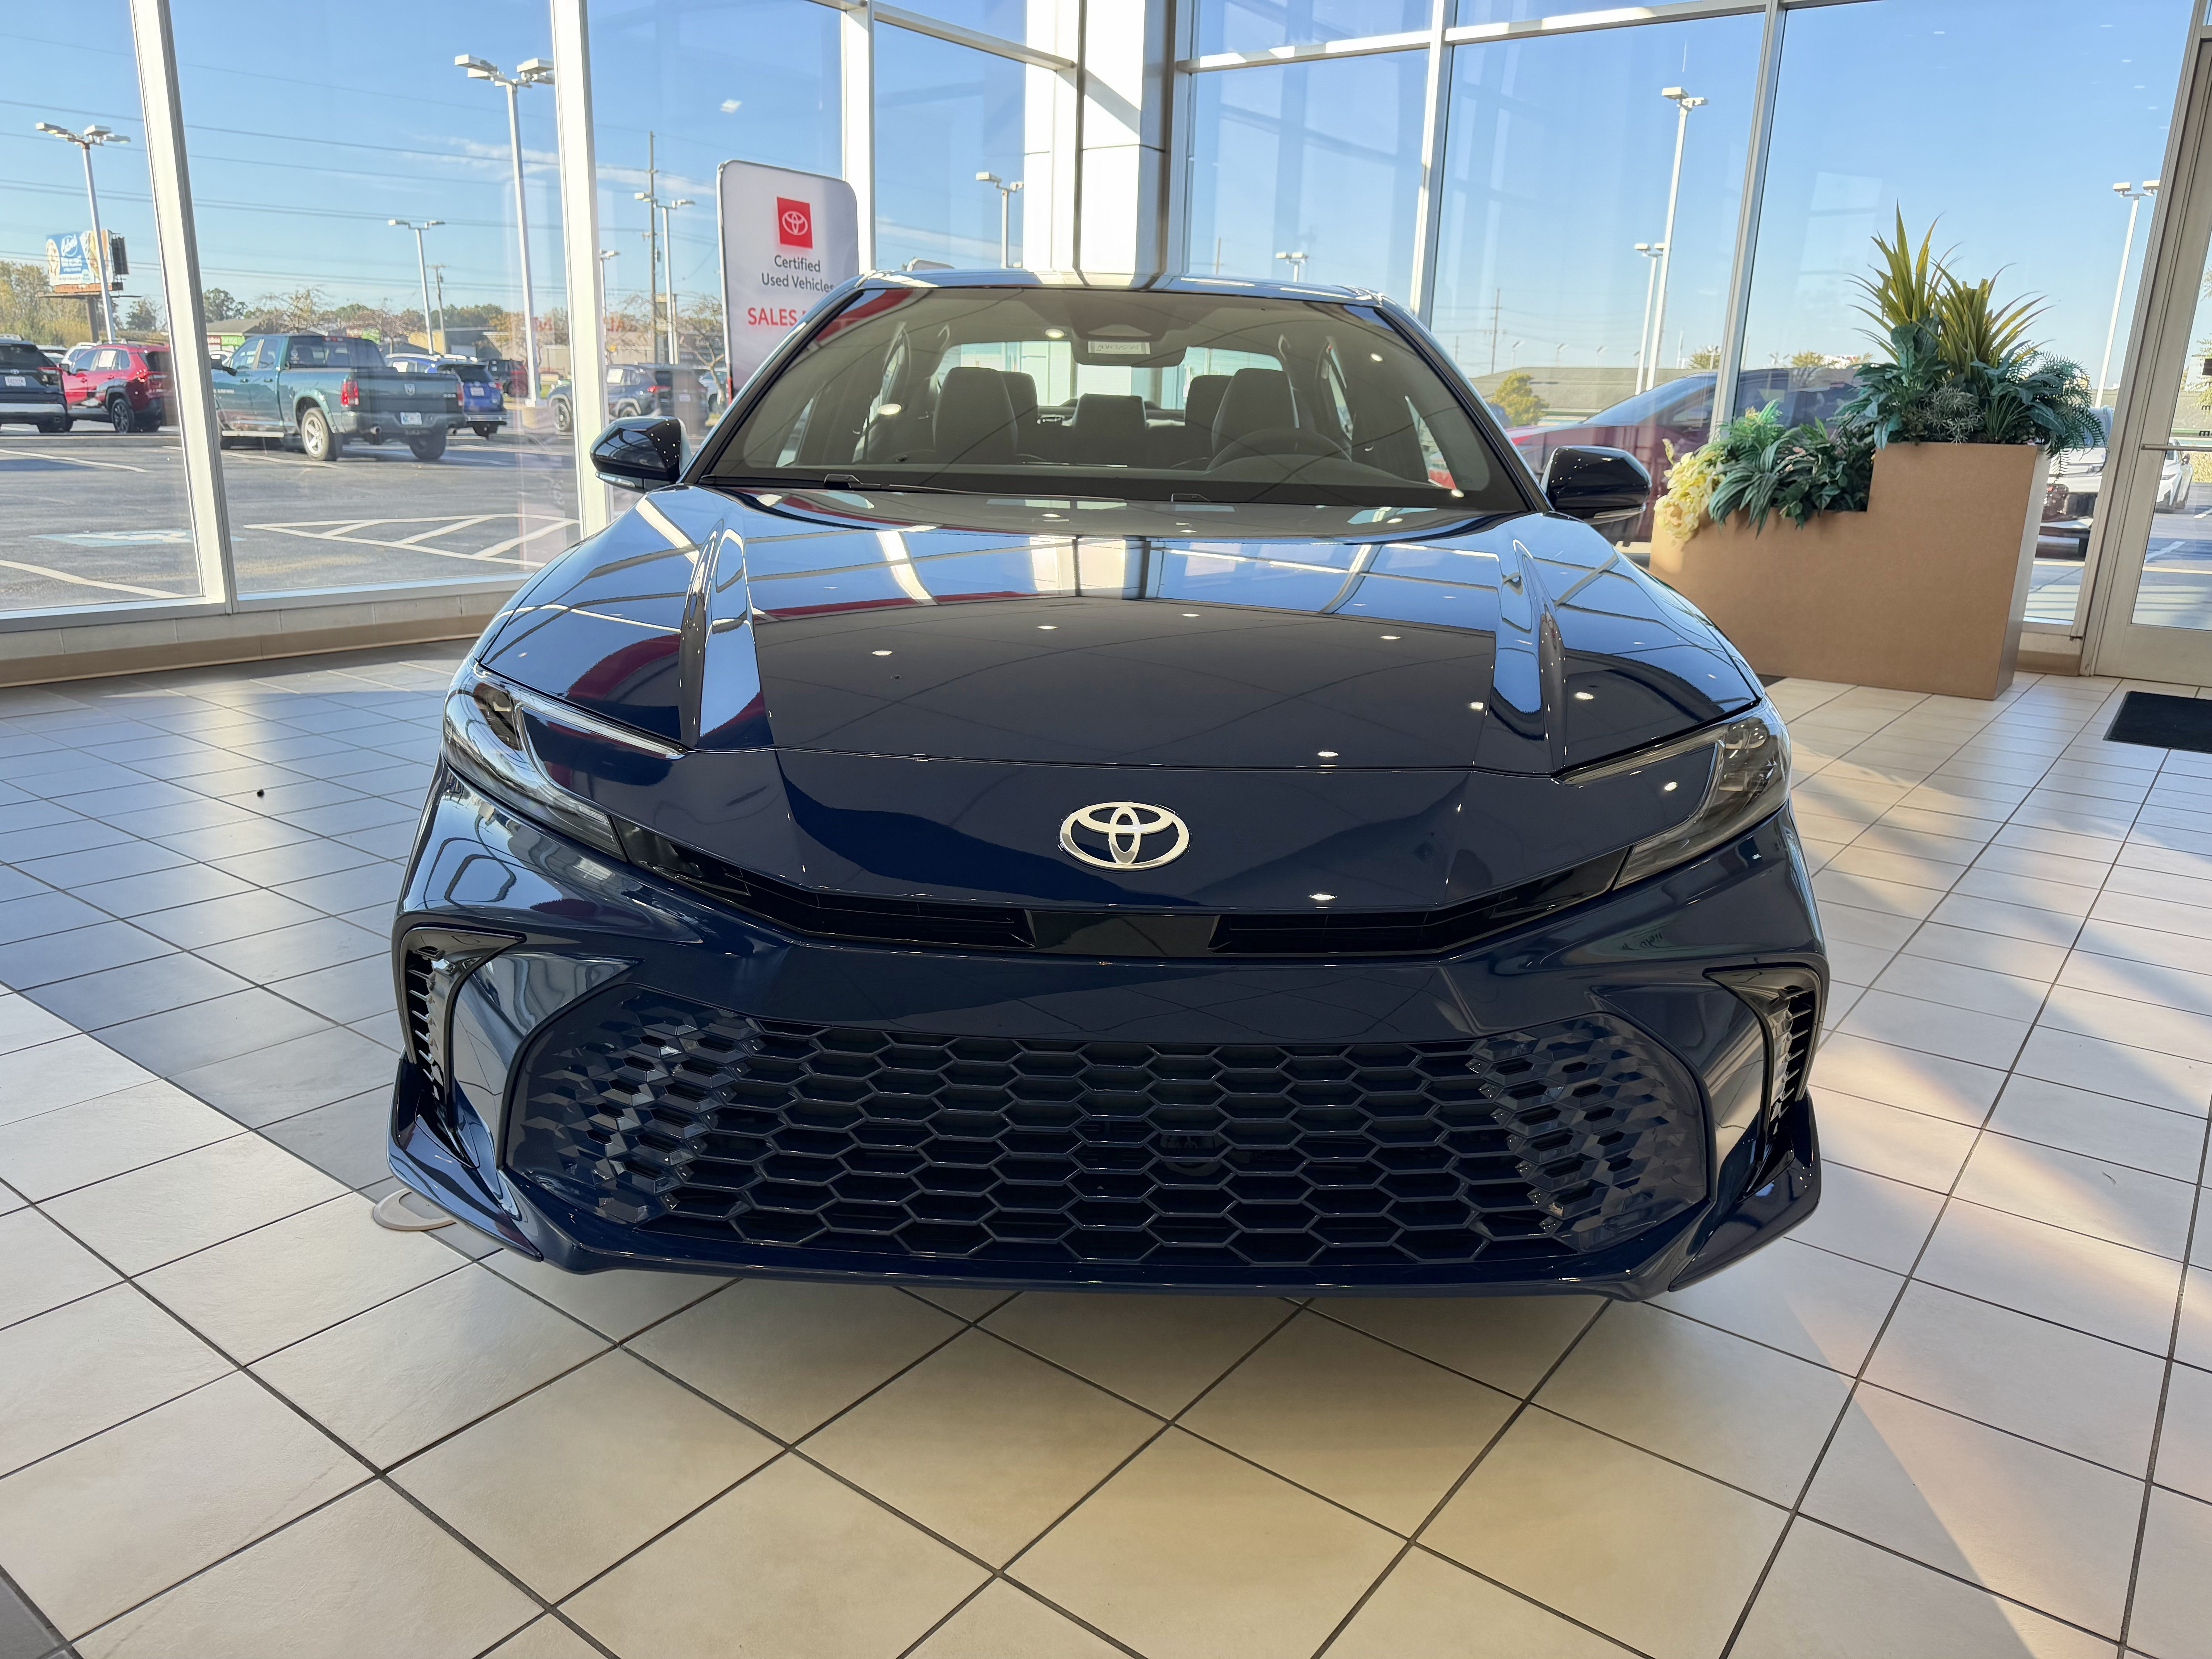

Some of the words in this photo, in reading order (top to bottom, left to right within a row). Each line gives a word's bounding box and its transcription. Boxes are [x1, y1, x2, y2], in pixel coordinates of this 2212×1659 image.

[775, 255, 821, 273] Certified
[762, 272, 789, 287] Used
[748, 307, 797, 326] SALES
